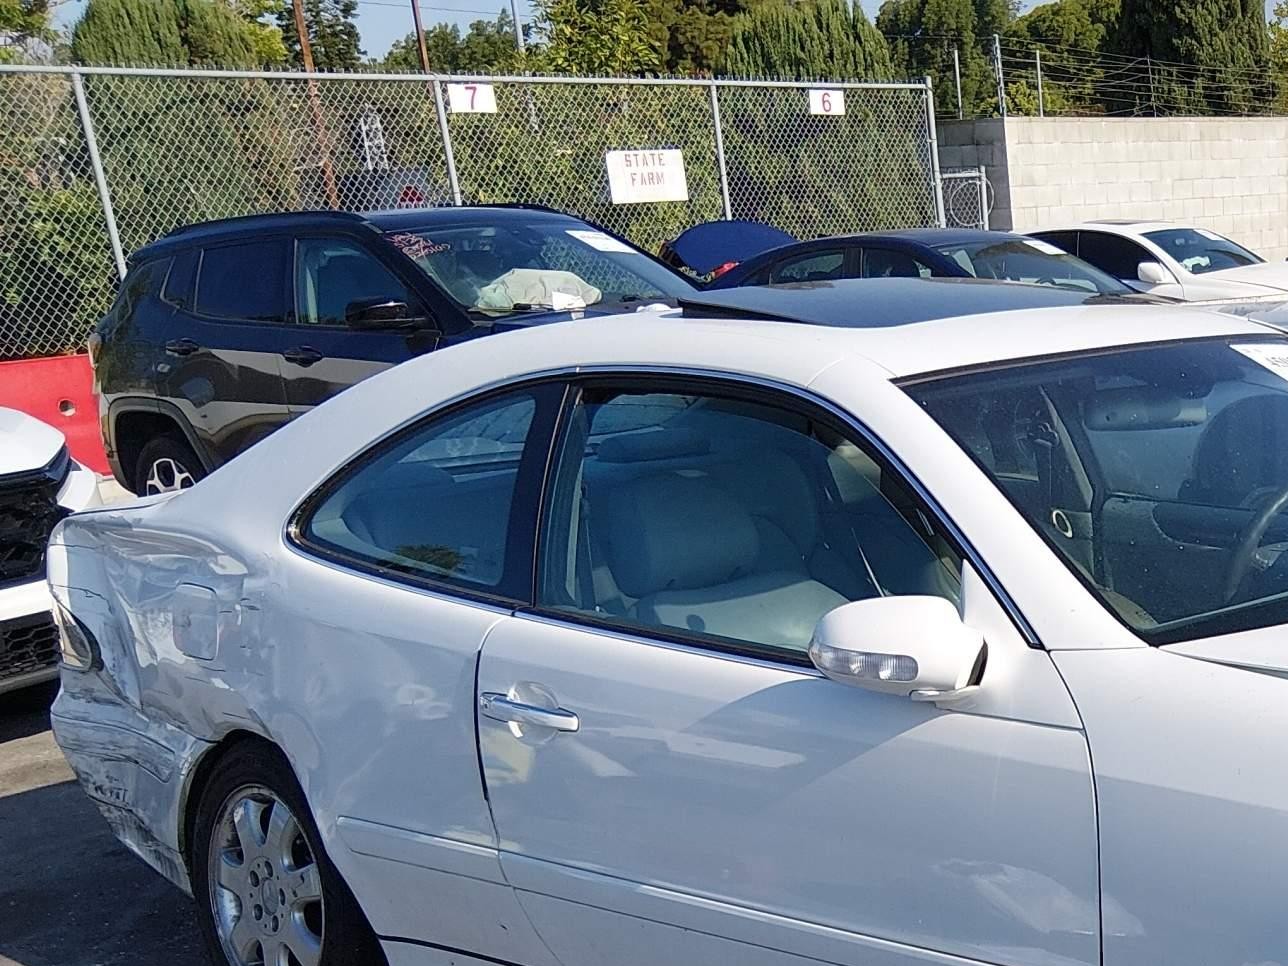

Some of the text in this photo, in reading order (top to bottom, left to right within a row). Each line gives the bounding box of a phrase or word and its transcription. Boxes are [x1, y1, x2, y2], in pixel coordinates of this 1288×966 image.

[465, 83, 478, 110] 7
[822, 92, 832, 112] 6
[624, 153, 666, 168] STATE
[630, 172, 665, 187] FARM
